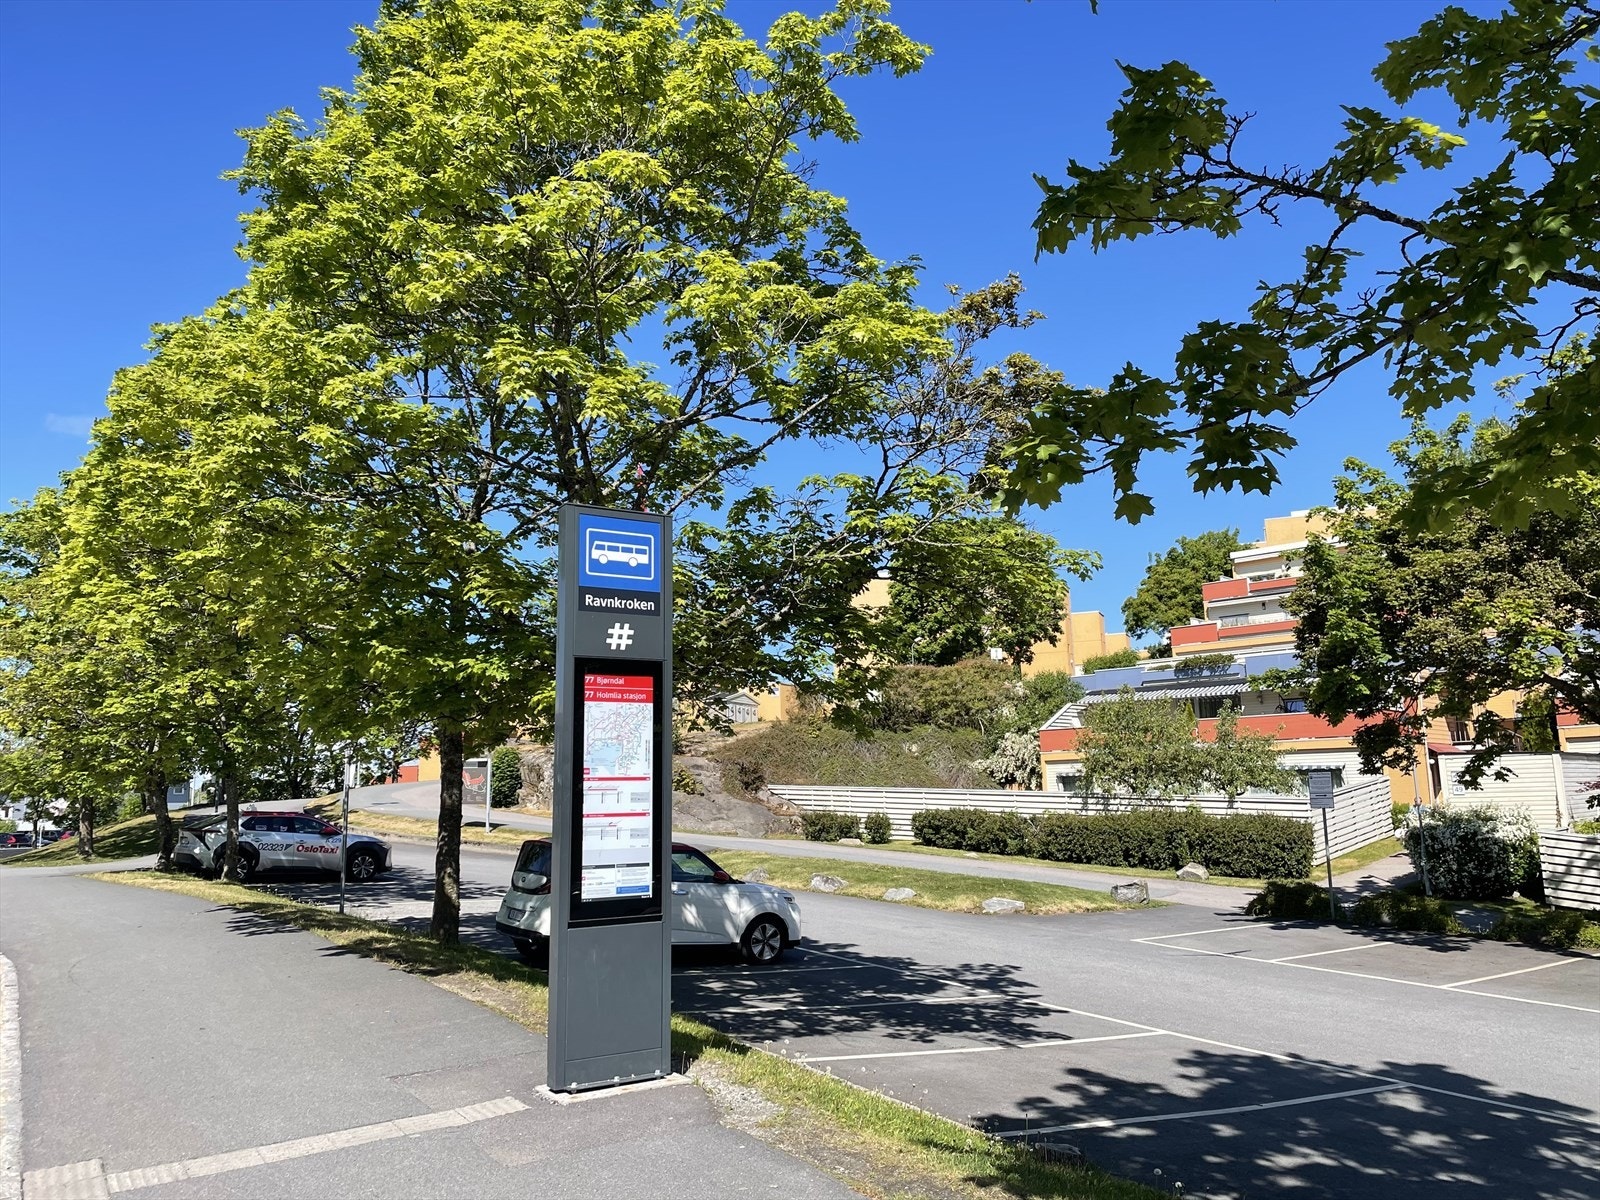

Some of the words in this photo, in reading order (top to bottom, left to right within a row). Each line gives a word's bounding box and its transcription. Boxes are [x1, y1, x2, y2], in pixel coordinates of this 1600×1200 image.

[585, 594, 655, 610] Ravnkroken
[596, 676, 625, 685] Bjørndal
[585, 690, 594, 698] 77
[596, 691, 622, 699] Holmlia
[623, 692, 647, 701] stasjon
[257, 842, 284, 851] 02323
[296, 844, 339, 854] OsloTaxi
